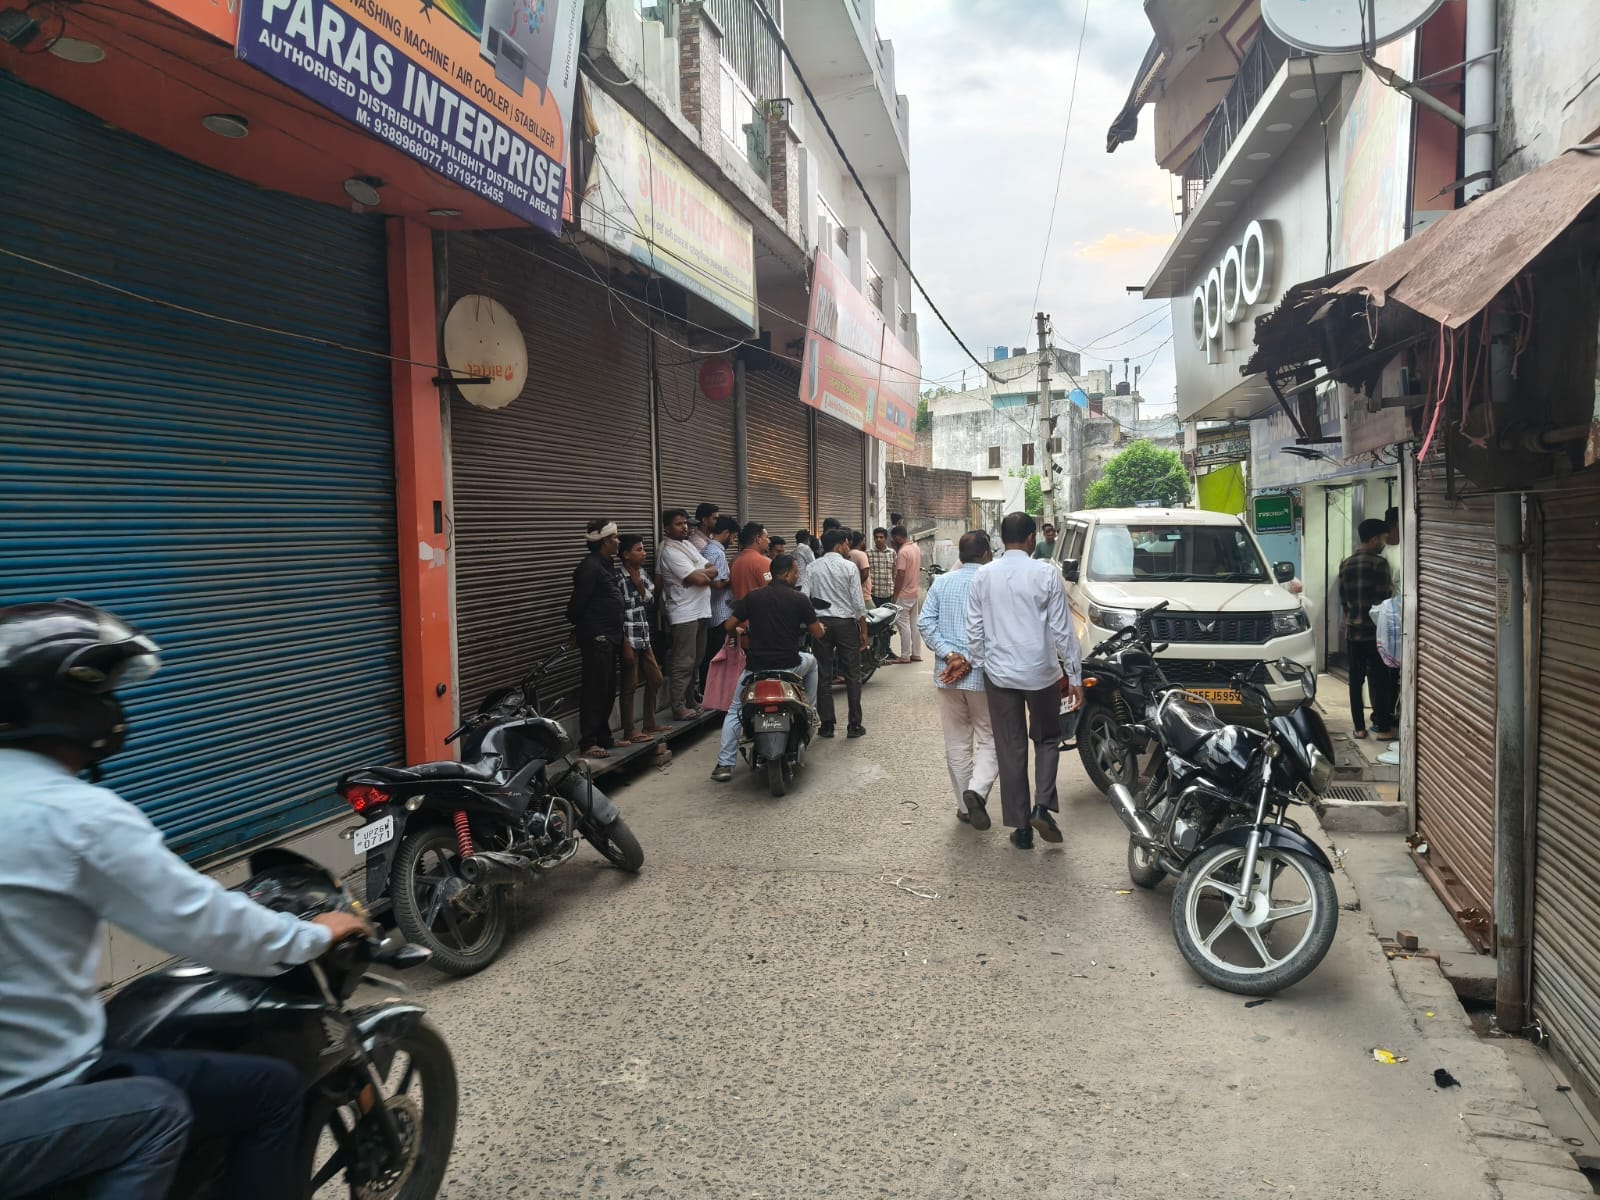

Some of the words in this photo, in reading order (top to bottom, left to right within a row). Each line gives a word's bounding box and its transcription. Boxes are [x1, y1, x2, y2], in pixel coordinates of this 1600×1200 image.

[258, 29, 356, 98] AUTHORISED
[358, 88, 439, 147] DISTRIBUTOR
[441, 140, 485, 176] PILIBHIT
[486, 166, 528, 202] DISTRICT
[529, 195, 558, 220] AREA'S
[402, 63, 561, 205] INTERPRISE
[404, 26, 450, 73] MACHINE
[456, 66, 473, 89] AIR
[474, 79, 510, 116] COOLER
[514, 108, 556, 149] STABILIZER
[355, 107, 371, 128] M:
[446, 162, 504, 204] 9719213455
[1192, 220, 1267, 365] oppo
[364, 830, 390, 849] 0771
